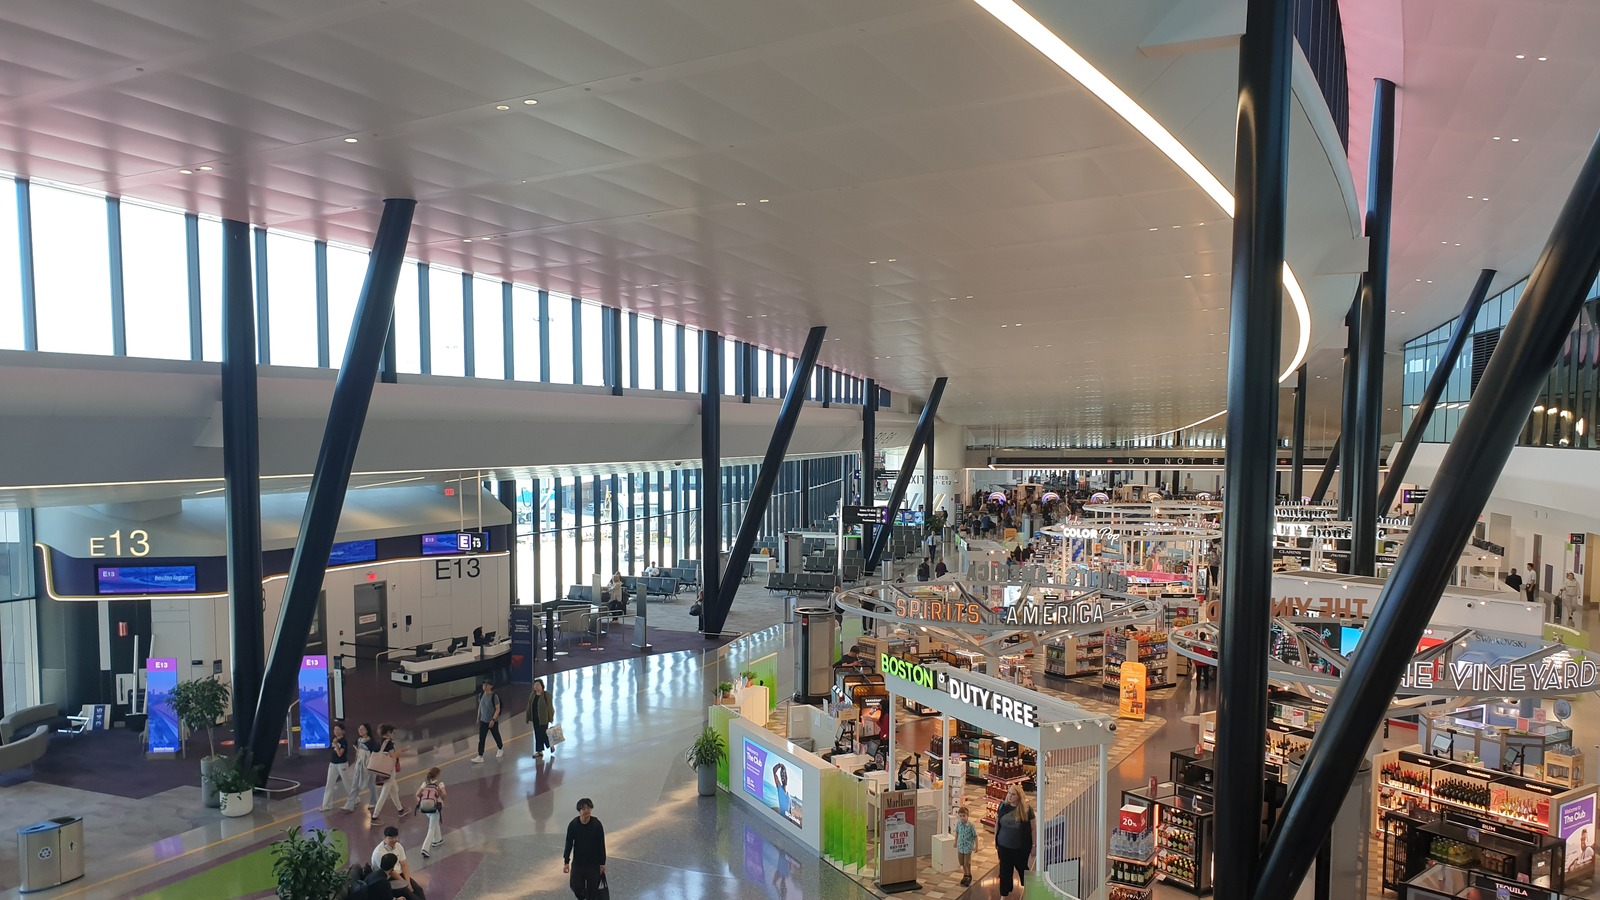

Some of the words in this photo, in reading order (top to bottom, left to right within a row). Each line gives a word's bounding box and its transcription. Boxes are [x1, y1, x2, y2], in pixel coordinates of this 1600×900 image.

[1128, 457, 1150, 465] DO
[1164, 457, 1195, 465] NOT
[910, 475, 925, 485] XIT
[1063, 527, 1098, 539] COLOR
[1099, 526, 1120, 546] Pop
[1272, 523, 1312, 538] UTY
[89, 529, 150, 556] E13
[460, 536, 469, 548] E
[435, 557, 481, 580] E13
[896, 598, 981, 623] SPIRITS
[1006, 604, 1104, 625] AMERICA
[1475, 634, 1527, 648] SWAROVSKI
[155, 661, 169, 669] E13
[1449, 660, 1598, 691] VINEYARD
[881, 653, 934, 690] BOSTON
[950, 678, 991, 711] DUTY
[993, 692, 1037, 729] FREE
[746, 751, 754, 762] The
[753, 755, 763, 767] Club
[1466, 769, 1491, 779] CHAMPAGNE
[1525, 783, 1552, 793] CHAMPAGNE
[1122, 817, 1137, 827] 20%
[1564, 815, 1574, 825] The
[1573, 810, 1586, 821] Club
[1495, 882, 1529, 897] TEQUILA
